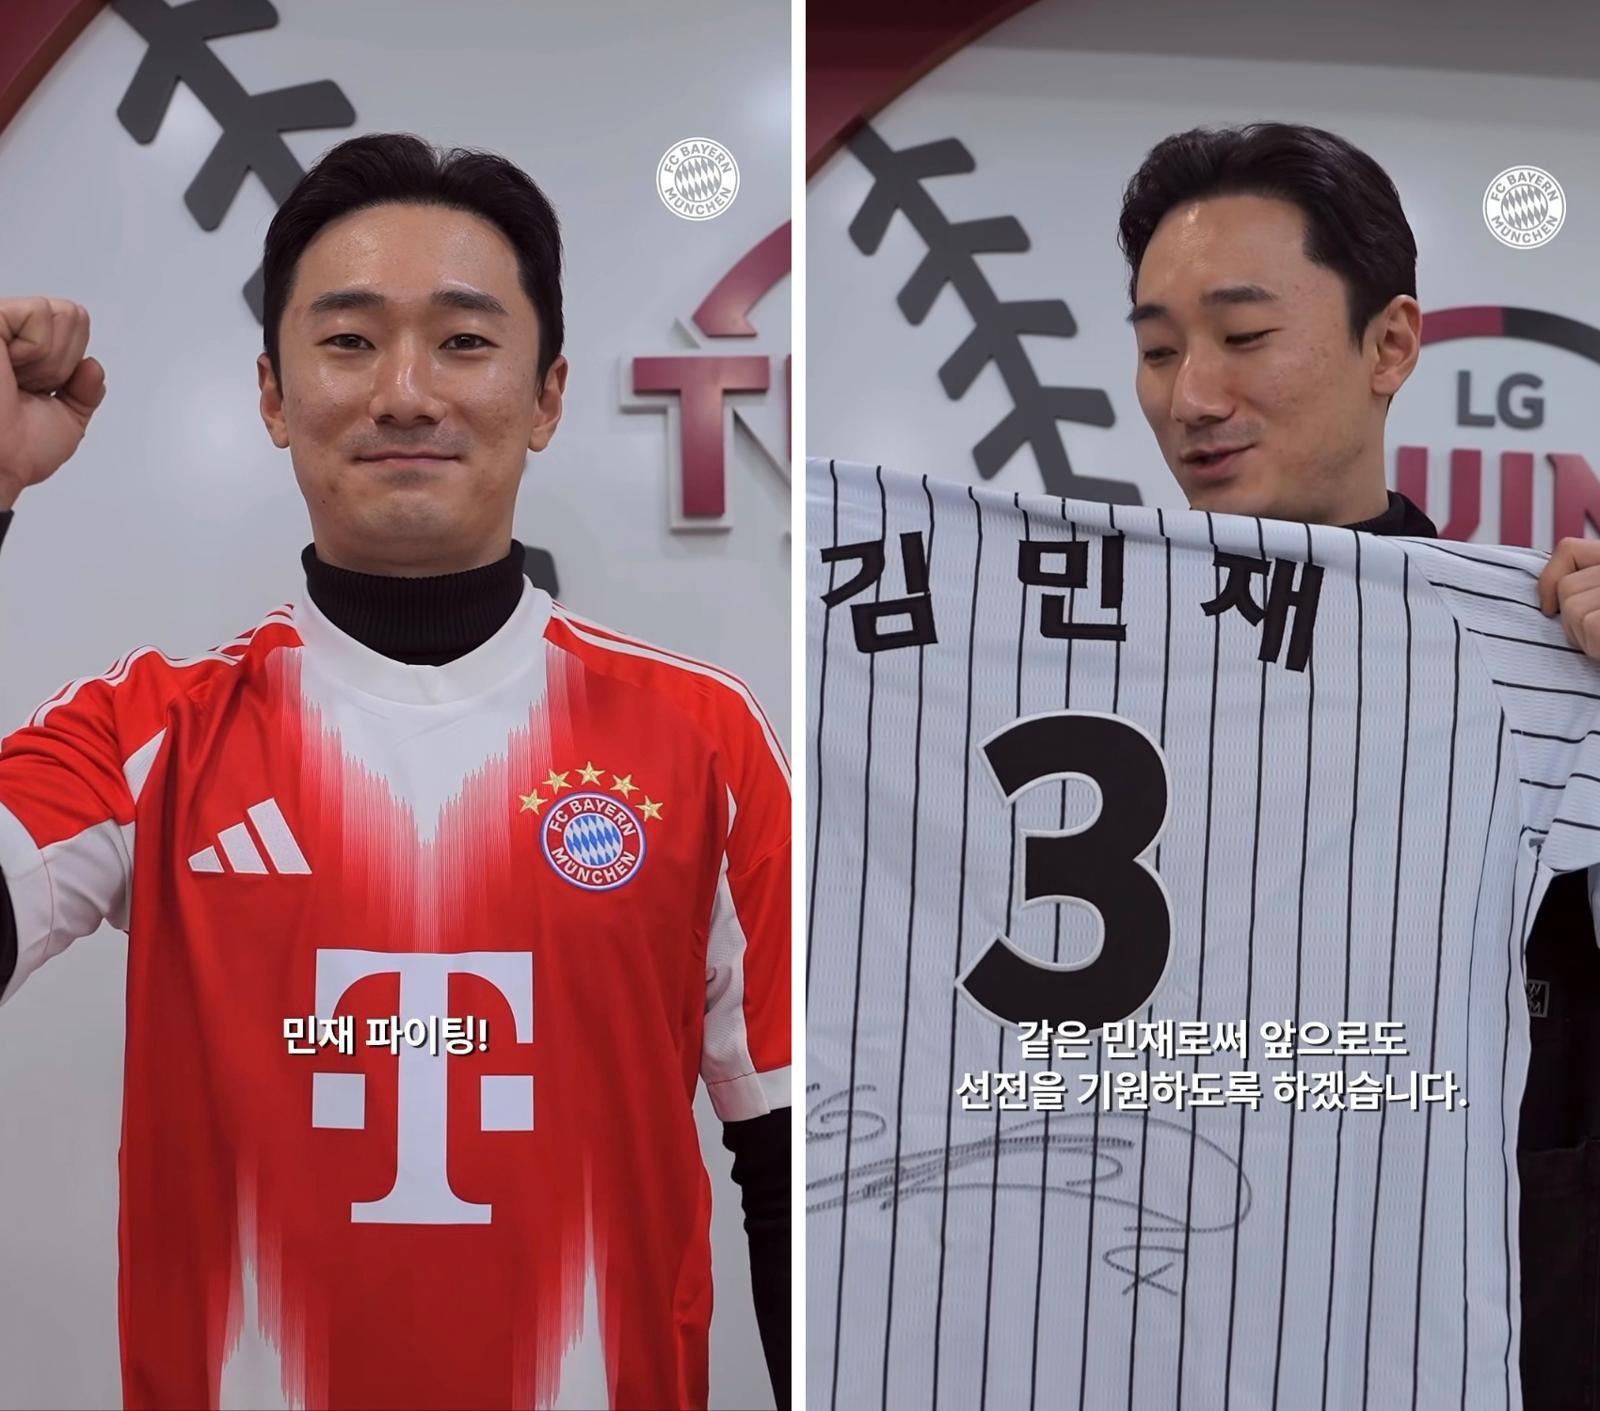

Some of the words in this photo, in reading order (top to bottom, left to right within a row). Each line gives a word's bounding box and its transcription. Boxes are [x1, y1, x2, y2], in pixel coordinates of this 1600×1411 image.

[1456, 370, 1545, 431] LG
[549, 810, 568, 832] FC
[569, 798, 636, 836] BAYERN
[955, 710, 1175, 1034] 3
